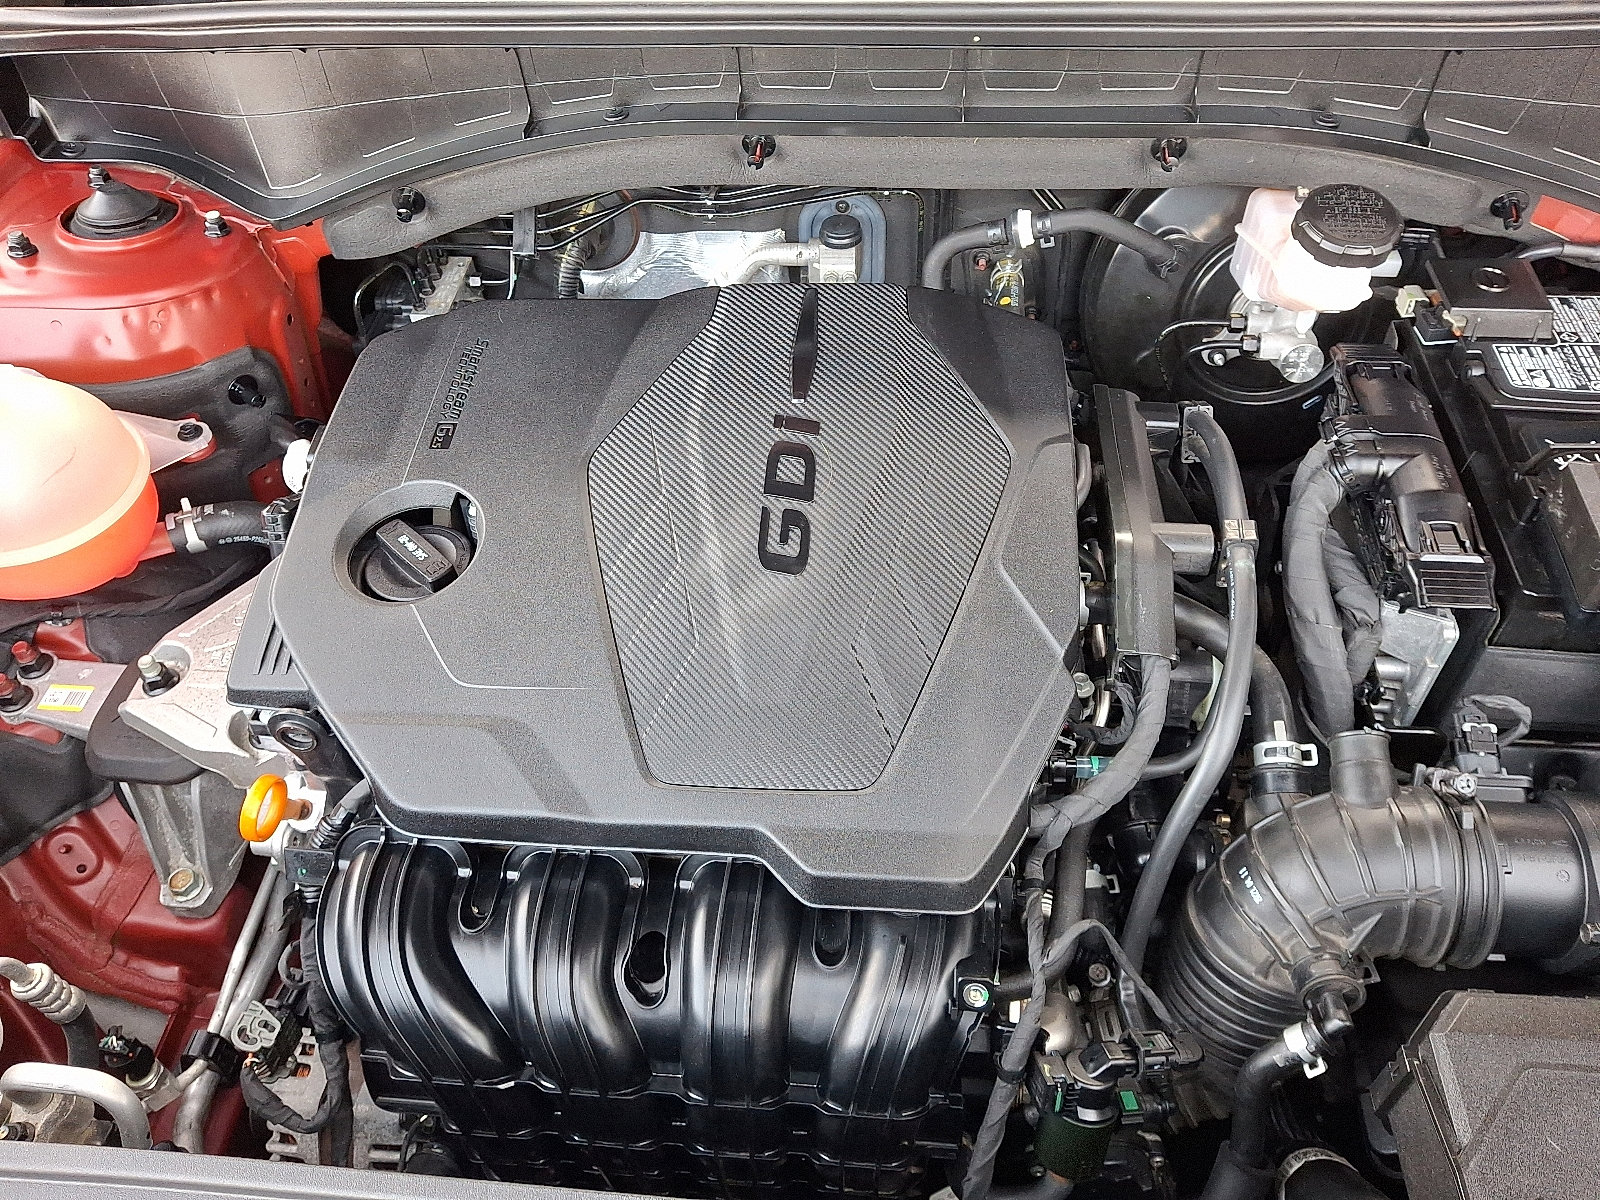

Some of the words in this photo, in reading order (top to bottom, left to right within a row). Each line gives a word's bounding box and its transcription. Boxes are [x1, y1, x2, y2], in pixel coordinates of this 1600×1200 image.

[441, 346, 473, 419] TECHNOLOGY
[450, 337, 489, 420] Smartstream
[758, 414, 821, 577] GDi
